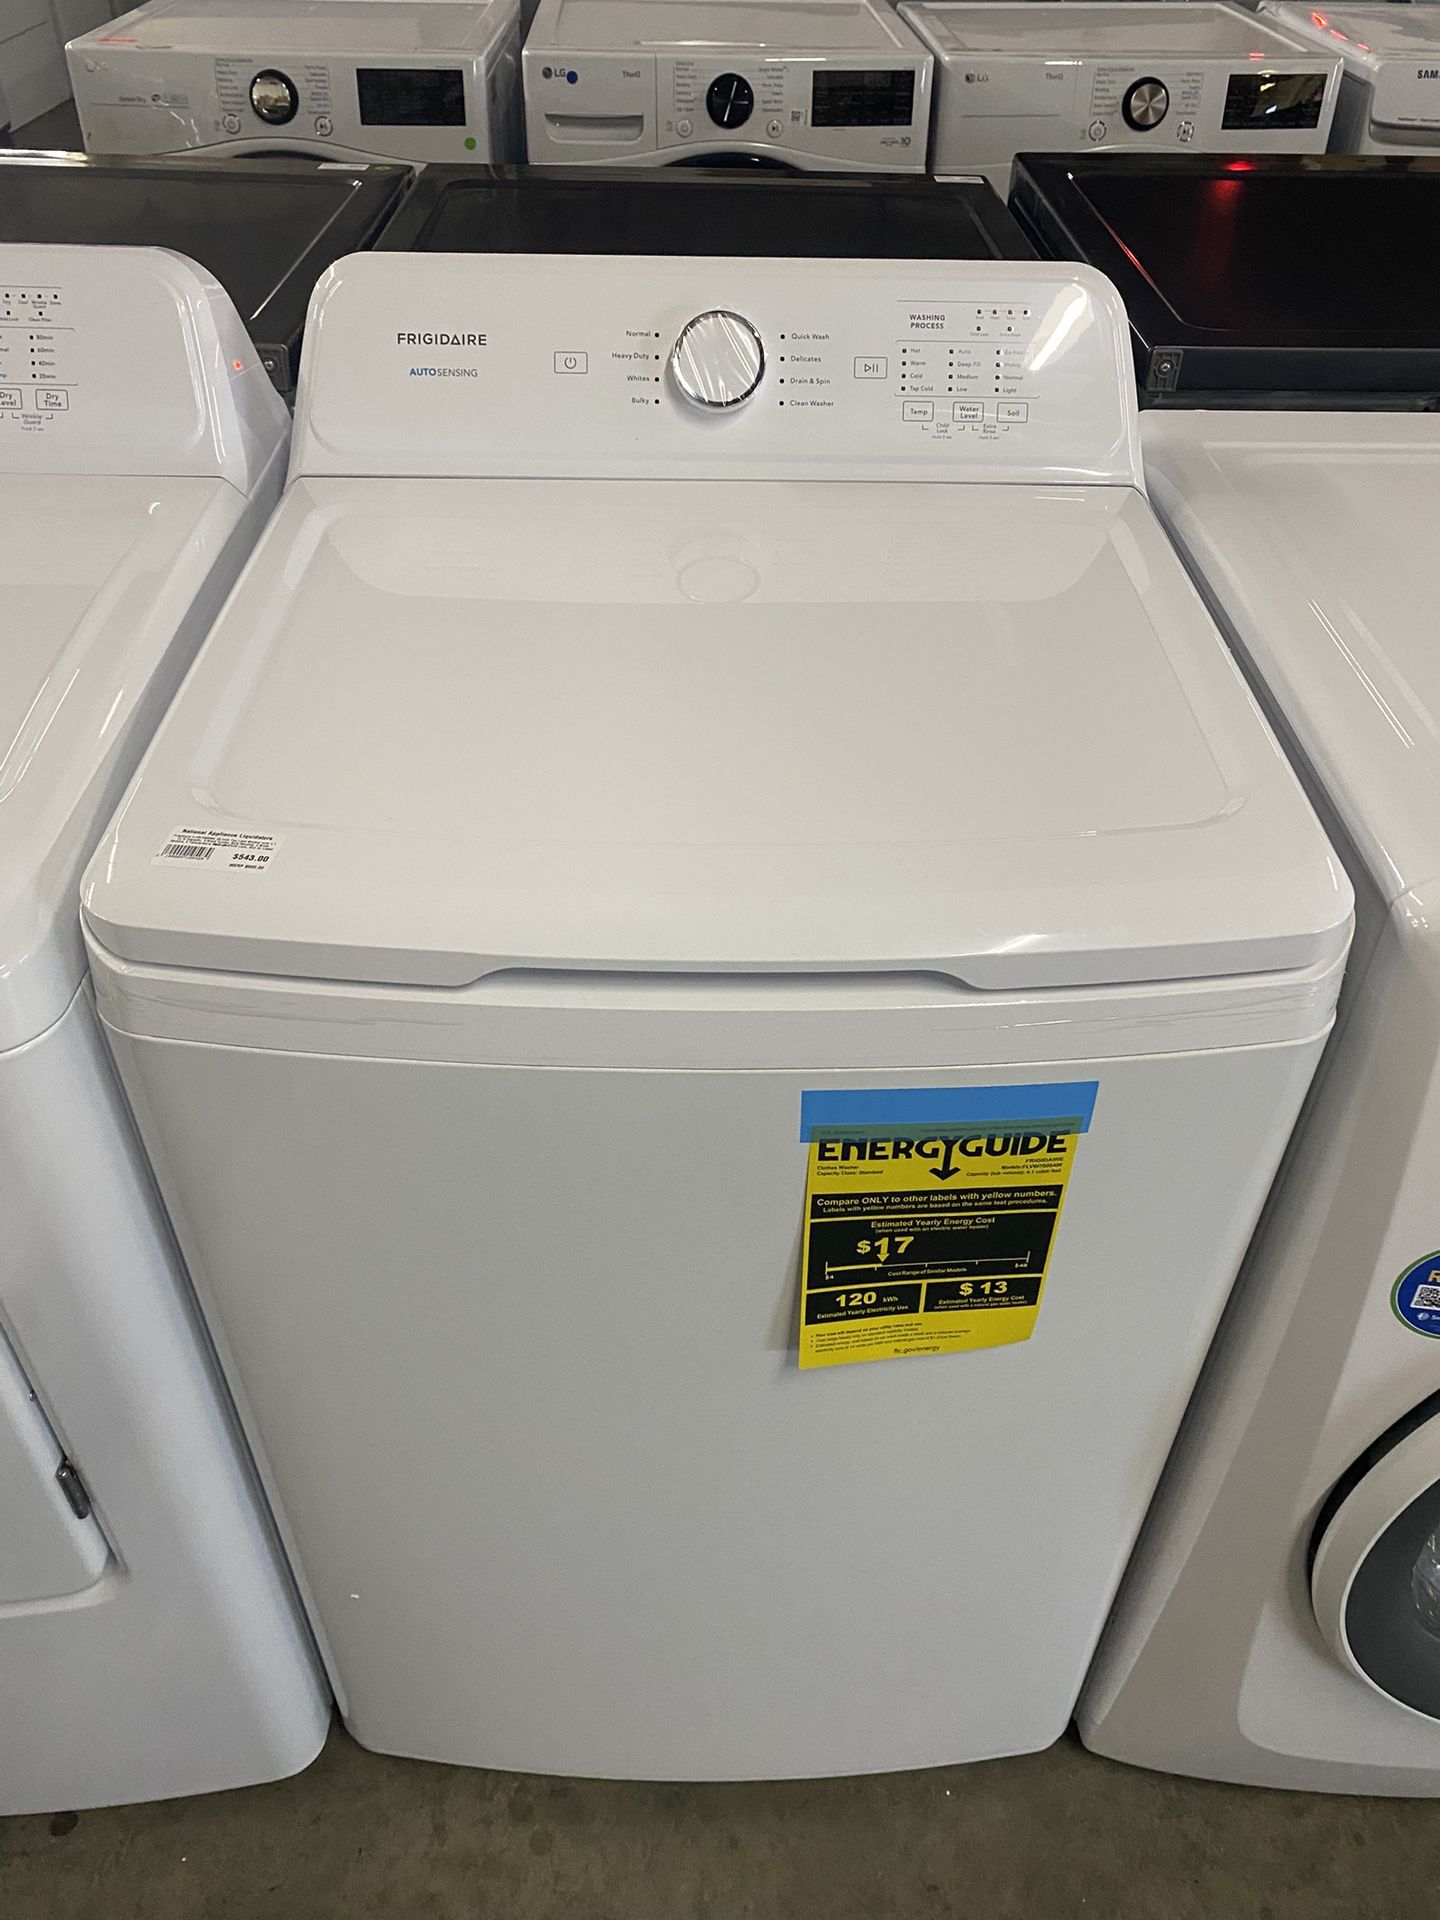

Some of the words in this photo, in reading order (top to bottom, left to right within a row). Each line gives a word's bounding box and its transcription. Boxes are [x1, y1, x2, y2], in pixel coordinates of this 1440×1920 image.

[554, 68, 566, 77] LG
[1417, 70, 1440, 79] SAM
[397, 333, 487, 346] FRIGIDAIRE
[612, 352, 632, 360] Heavy
[633, 352, 649, 360] Duty
[409, 368, 478, 378] AUTOSENSING
[816, 378, 830, 386] Spin
[46, 393, 59, 401] Dry
[632, 397, 649, 405] Bulky
[910, 408, 928, 416] Temp
[233, 853, 269, 862] $543.00
[818, 1130, 1071, 1162] ENERGYGUIDE
[817, 1198, 860, 1207] Compare
[861, 1196, 890, 1204] ONLY
[930, 1194, 957, 1202] labels
[981, 1192, 1012, 1201] yellow
[1013, 1190, 1057, 1198] numbers.
[1007, 1198, 1048, 1206] procedures.
[871, 1220, 913, 1228] Estimated
[915, 1219, 942, 1227] Yearly
[944, 1217, 973, 1225] Energy
[856, 1236, 914, 1257] $17
[959, 1282, 973, 1296] $
[980, 1281, 1008, 1295] 13
[836, 1291, 877, 1307] 120
[817, 1311, 847, 1319] Estimated
[867, 1305, 896, 1314] Electricity
